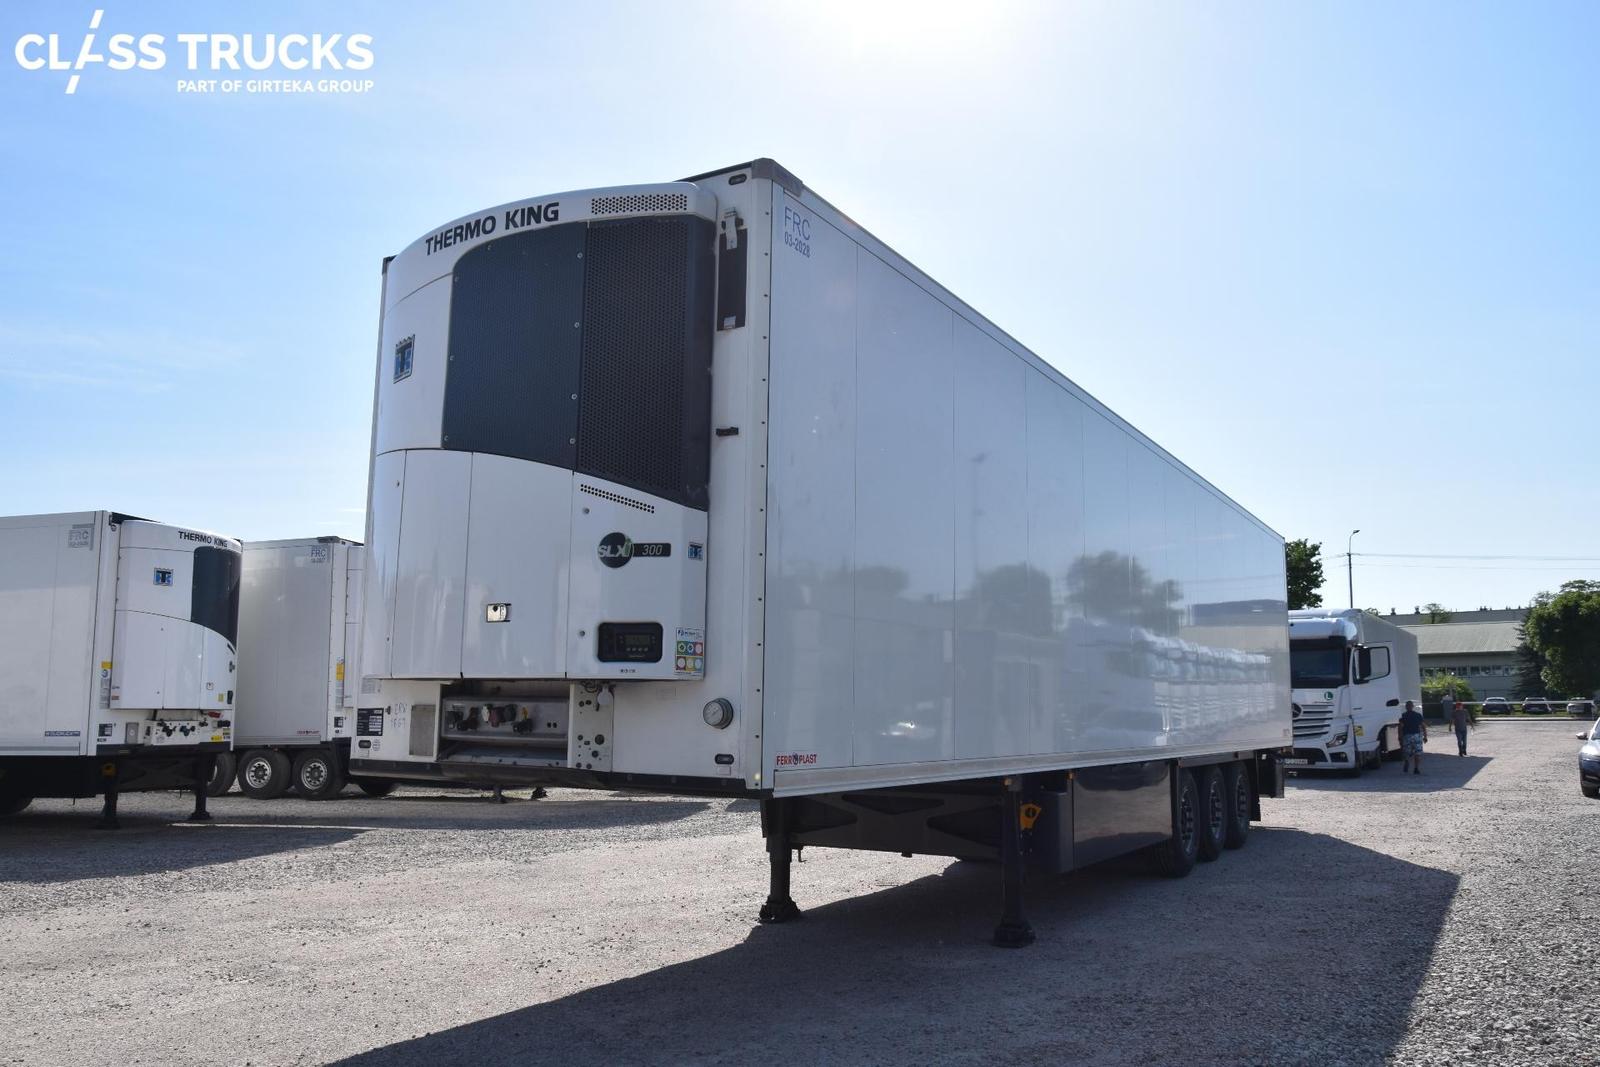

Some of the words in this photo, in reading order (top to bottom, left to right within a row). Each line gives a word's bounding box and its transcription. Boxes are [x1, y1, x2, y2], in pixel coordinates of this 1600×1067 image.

[425, 215, 497, 256] THERMO
[504, 202, 560, 230] KING
[784, 206, 811, 241] FRC
[178, 530, 213, 544] THERMO
[213, 537, 229, 548] KING
[641, 544, 663, 556] 300
